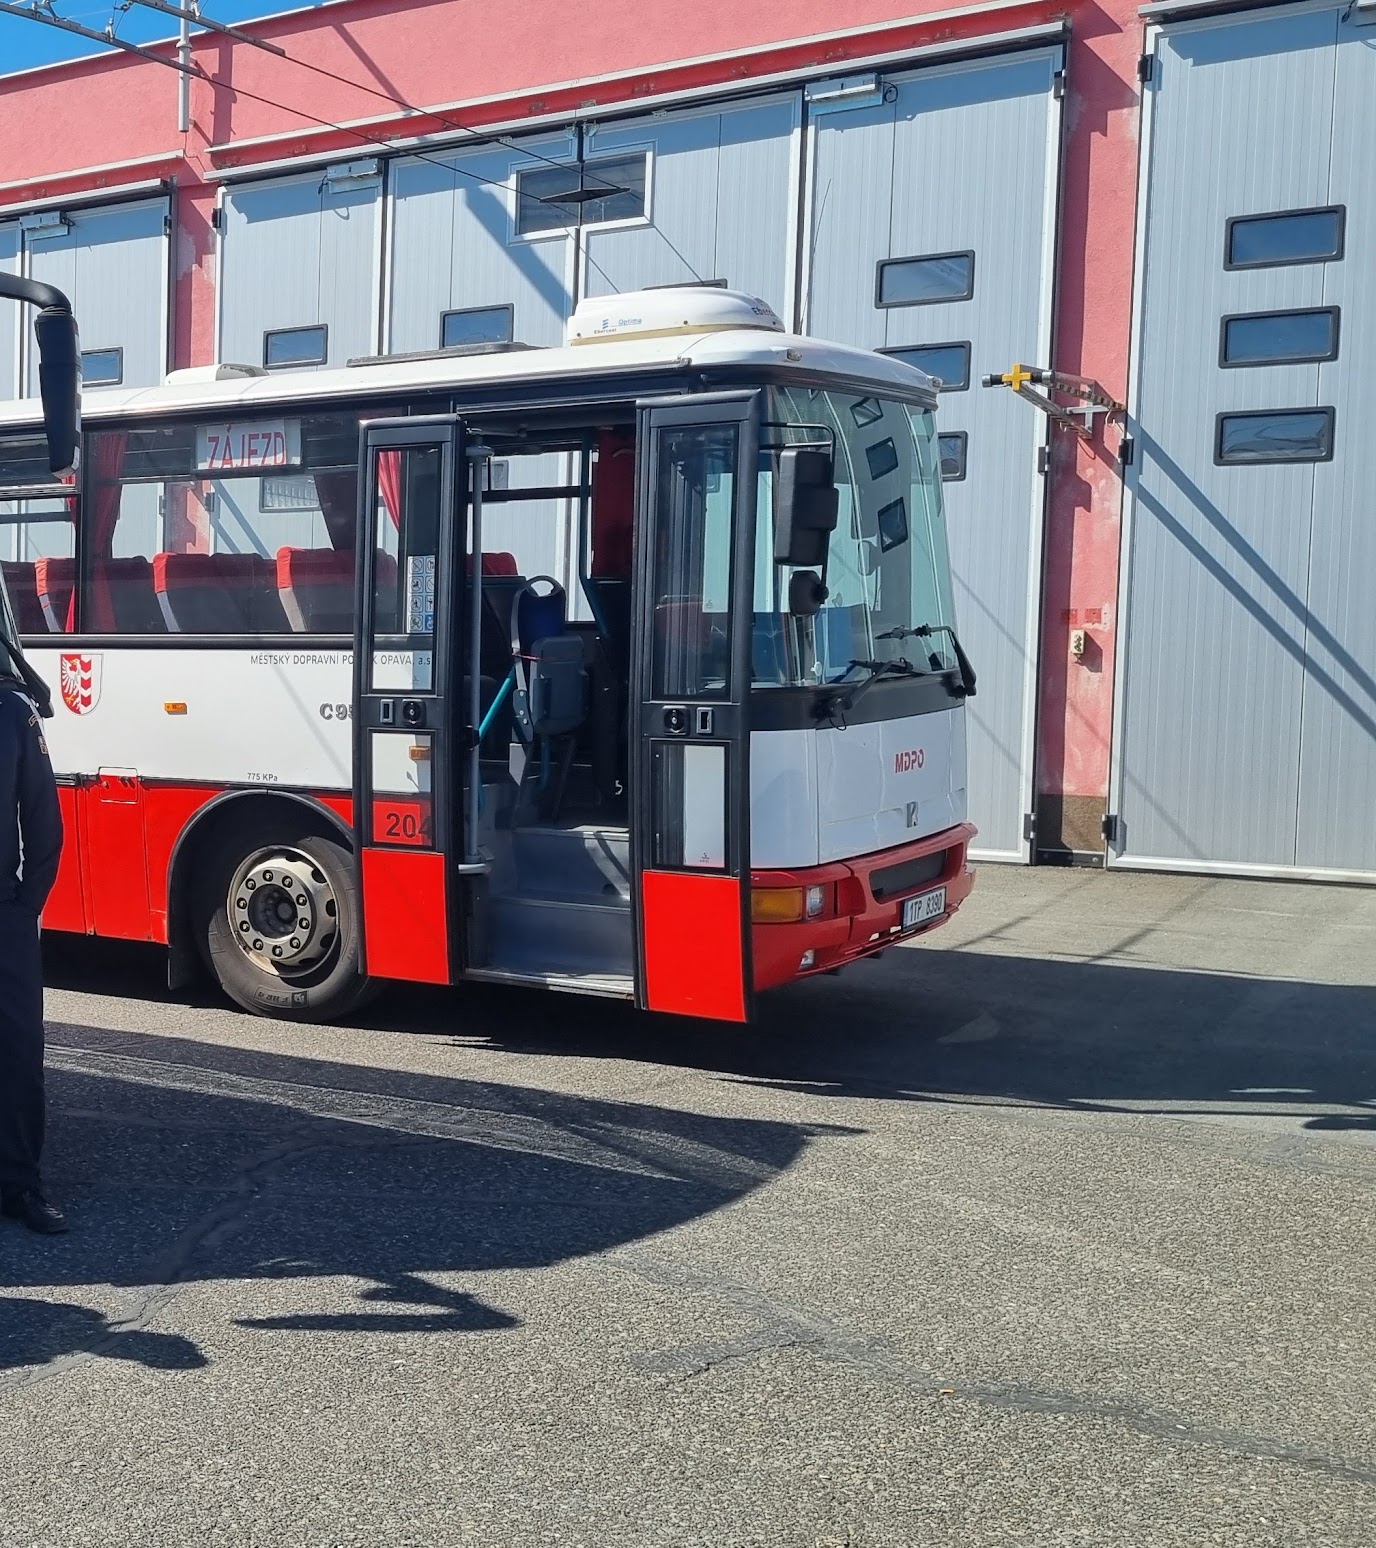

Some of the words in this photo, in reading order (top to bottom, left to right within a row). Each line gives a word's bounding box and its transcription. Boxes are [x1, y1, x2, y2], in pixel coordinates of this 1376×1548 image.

[207, 424, 286, 469] ZÁJEZD
[250, 652, 290, 665] MĚSTSKÝ
[293, 652, 339, 665] DOPRAVNÍ
[894, 748, 924, 773] MDPO
[247, 773, 261, 781] 775
[262, 773, 278, 782] KPa
[386, 812, 432, 839] 204
